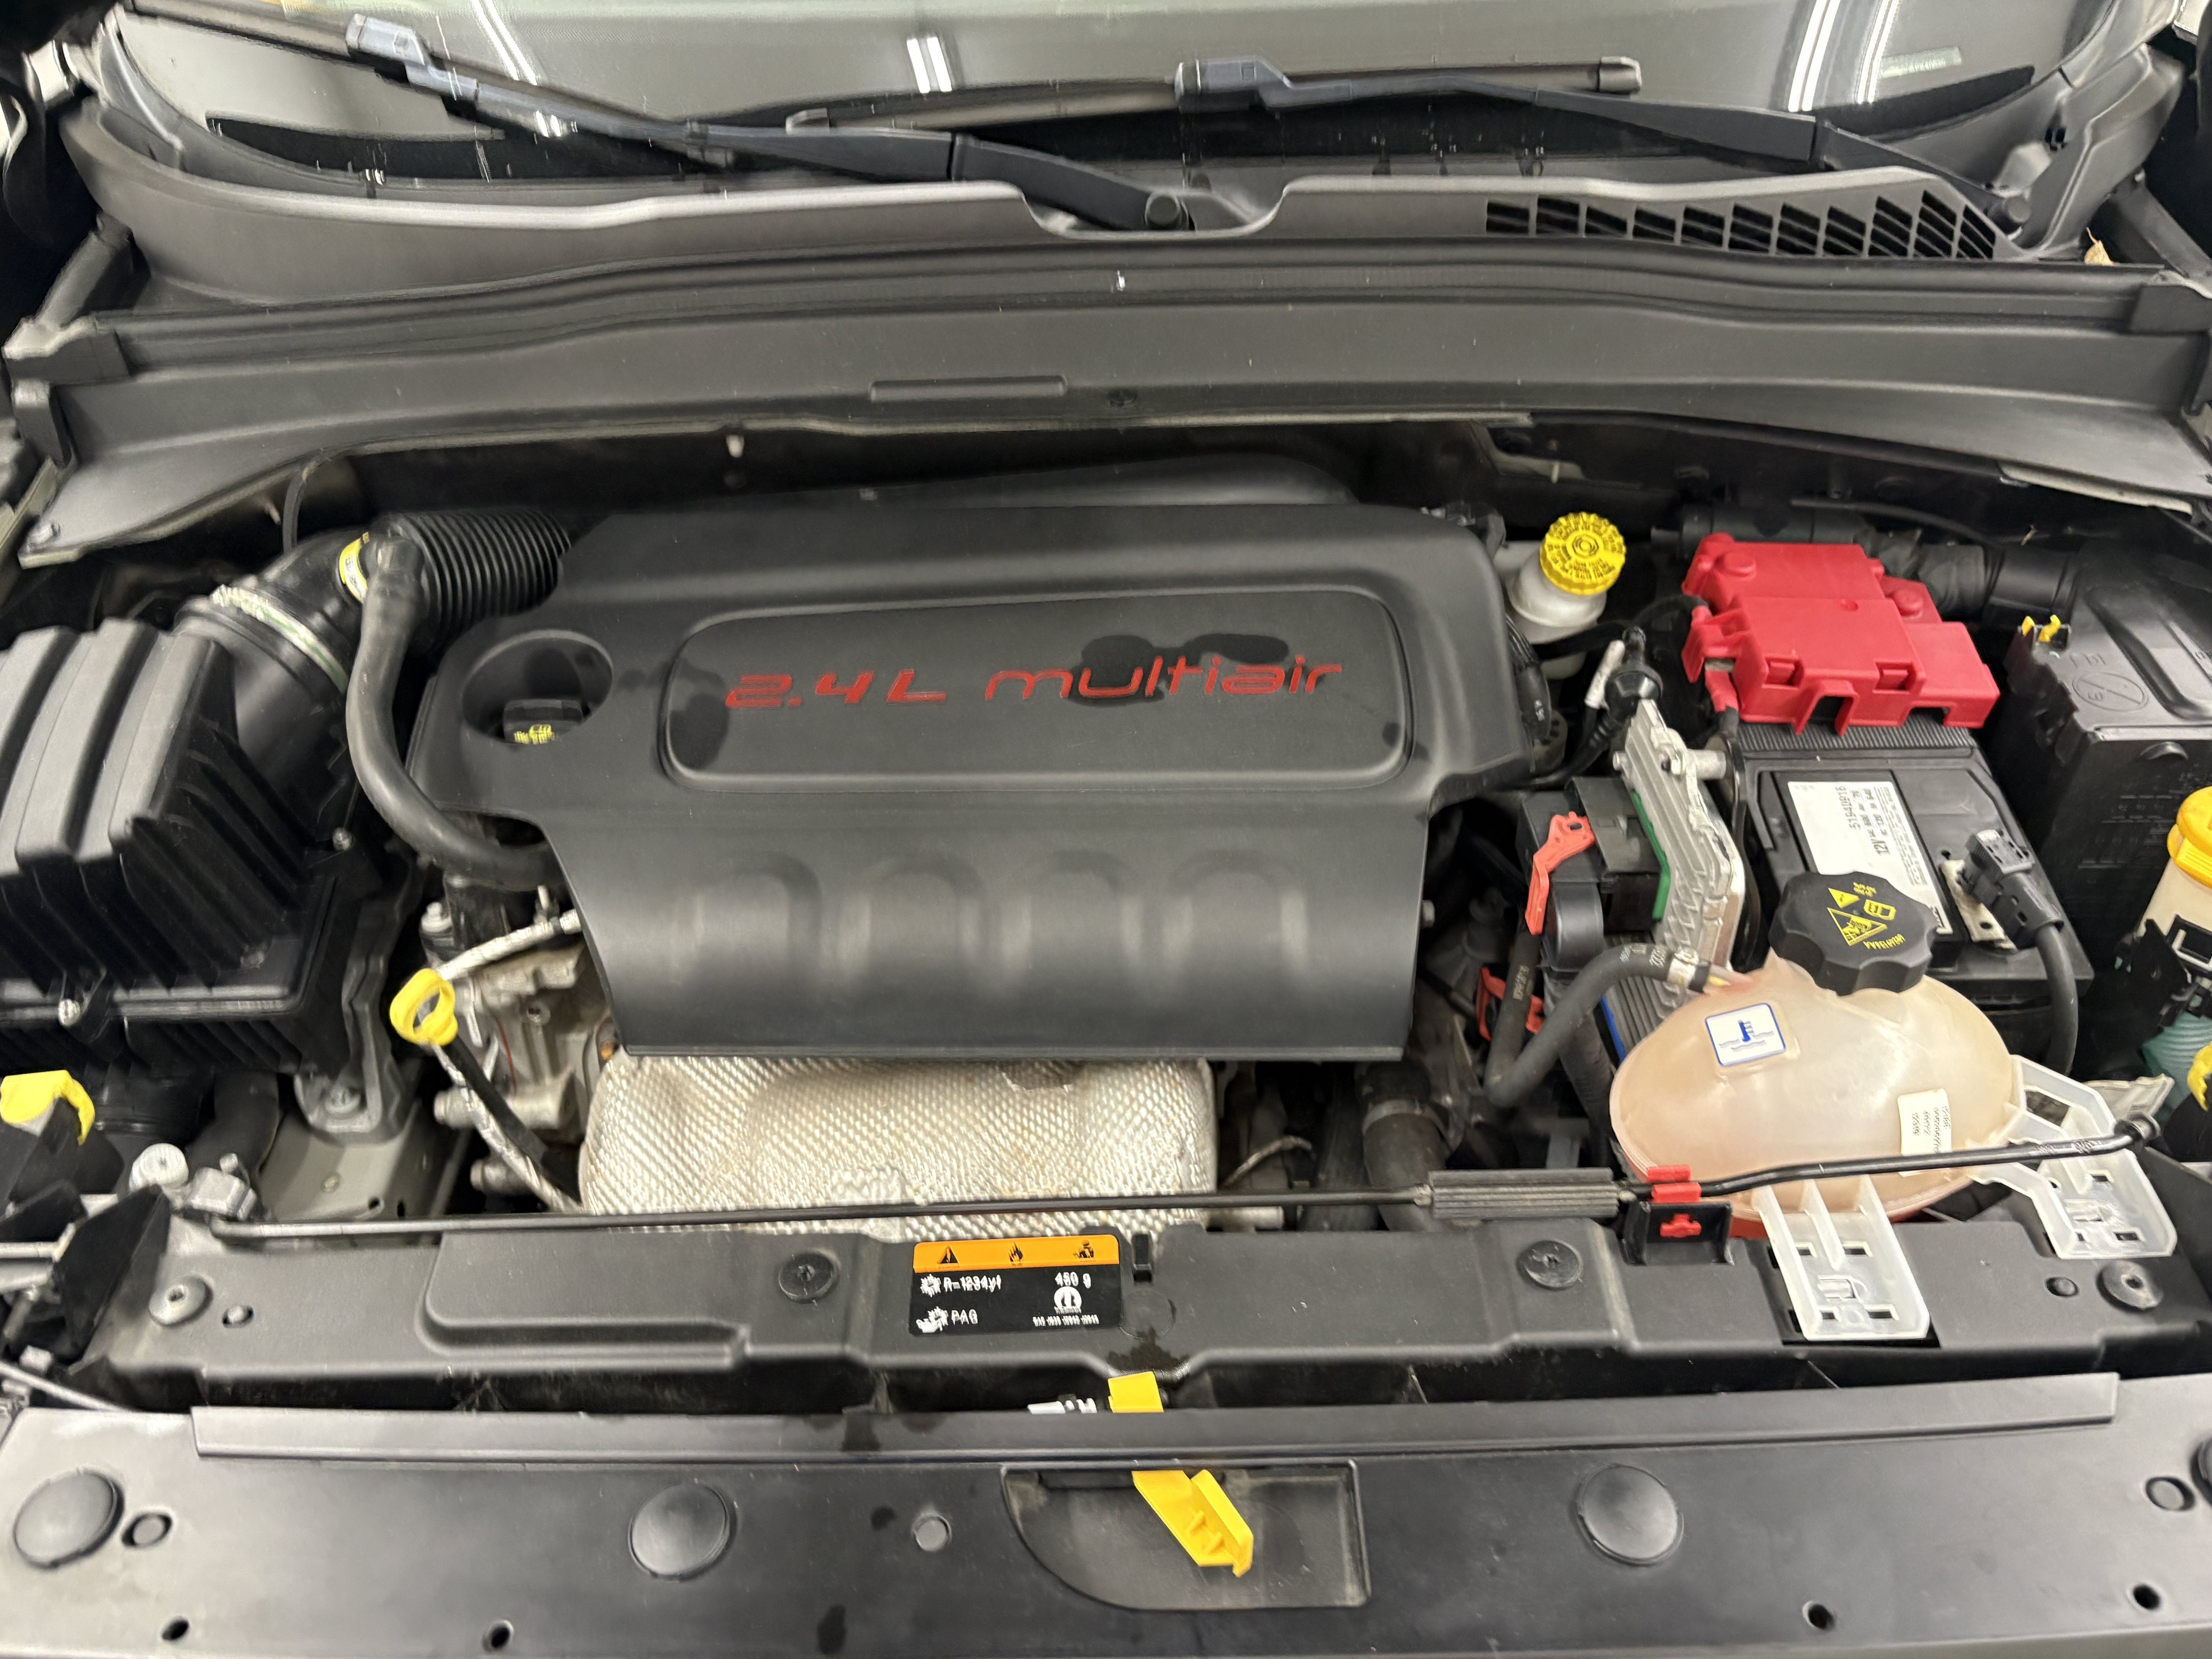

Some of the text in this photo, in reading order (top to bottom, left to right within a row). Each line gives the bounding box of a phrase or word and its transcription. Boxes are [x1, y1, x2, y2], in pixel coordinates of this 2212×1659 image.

[984, 654, 1343, 701] multiair
[1055, 1272, 1079, 1286] 450
[951, 1309, 978, 1325] PAG
